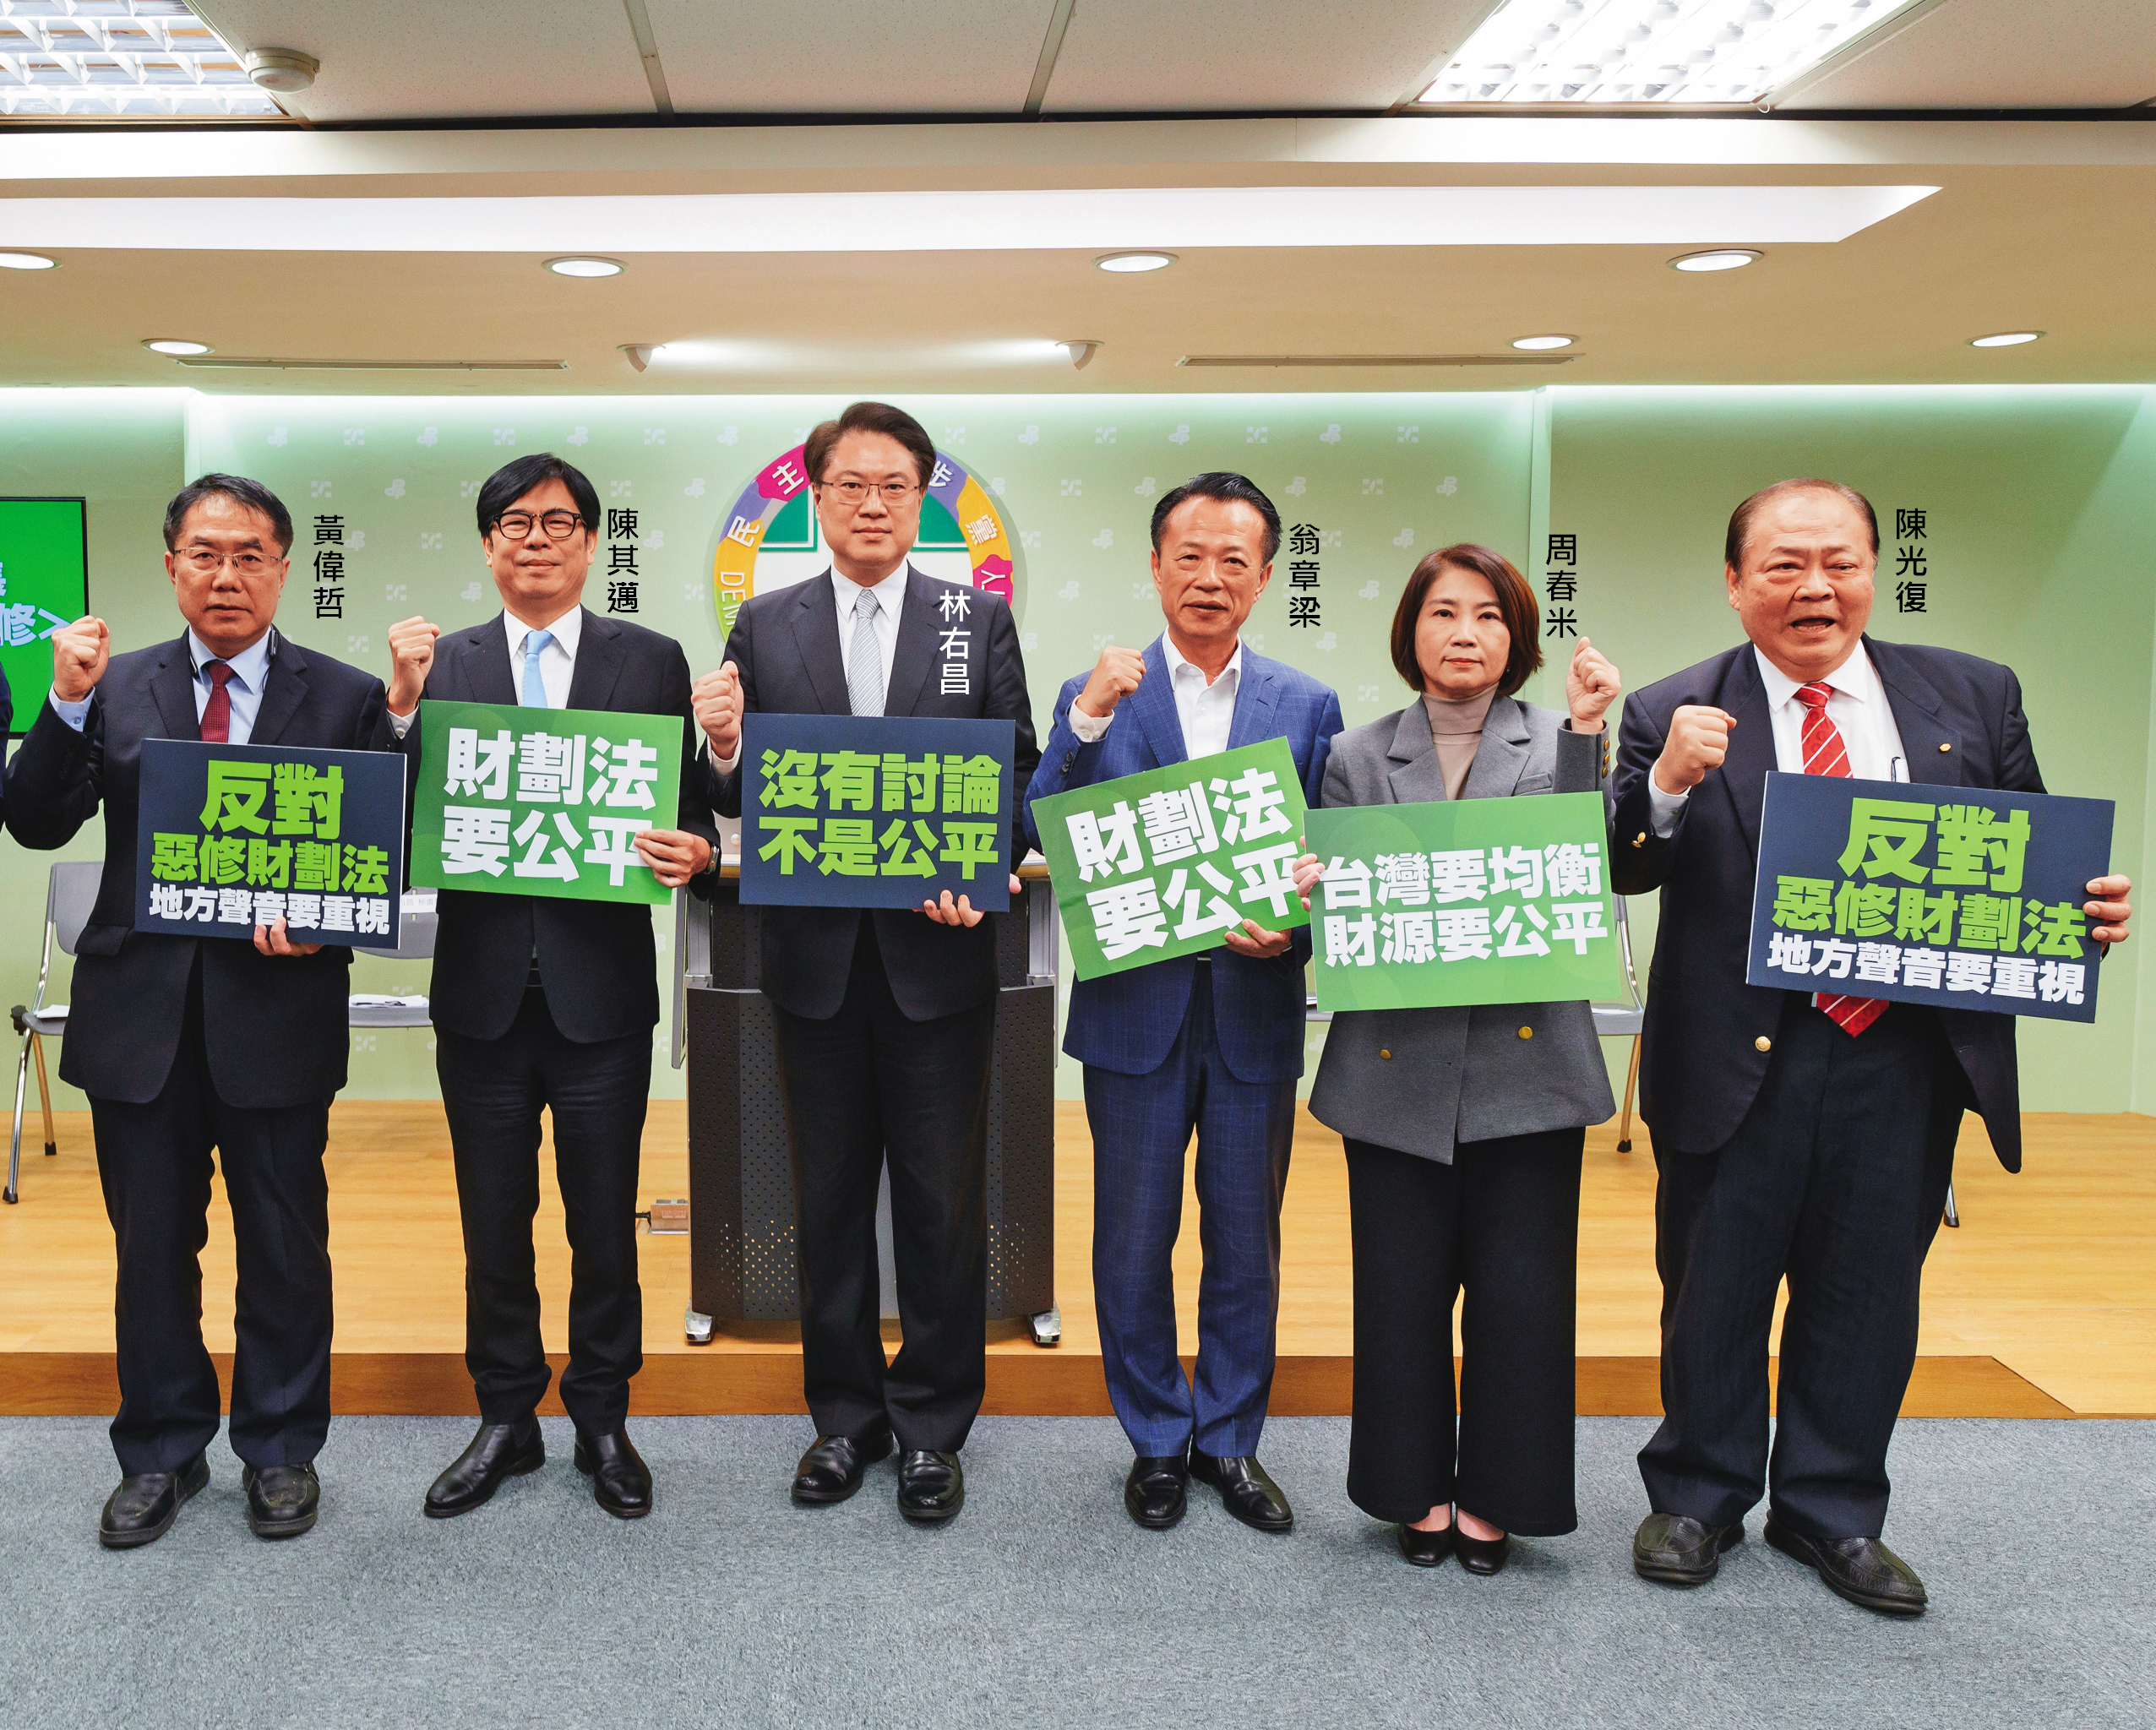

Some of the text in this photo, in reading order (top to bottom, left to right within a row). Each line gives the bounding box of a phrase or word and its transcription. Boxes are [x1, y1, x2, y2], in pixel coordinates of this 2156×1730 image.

[199, 759, 344, 840] 反對
[443, 727, 658, 811] 財劃法
[759, 748, 1003, 814] 沒有討論
[151, 832, 389, 895] 惡修財劃法
[440, 805, 654, 887] 要公平
[758, 816, 999, 880] 不是公平
[1064, 767, 1293, 884] 財劃法
[1837, 797, 2031, 893] 反對
[149, 883, 390, 935] 地方聲音要重視
[1086, 841, 1299, 961] 要公平
[1319, 842, 1602, 910] 台灣要均衡
[1324, 901, 1609, 968] 財源要公平
[1772, 874, 2087, 959] 惡修財劃法
[1767, 932, 2086, 1004] 地方聲音要重視
